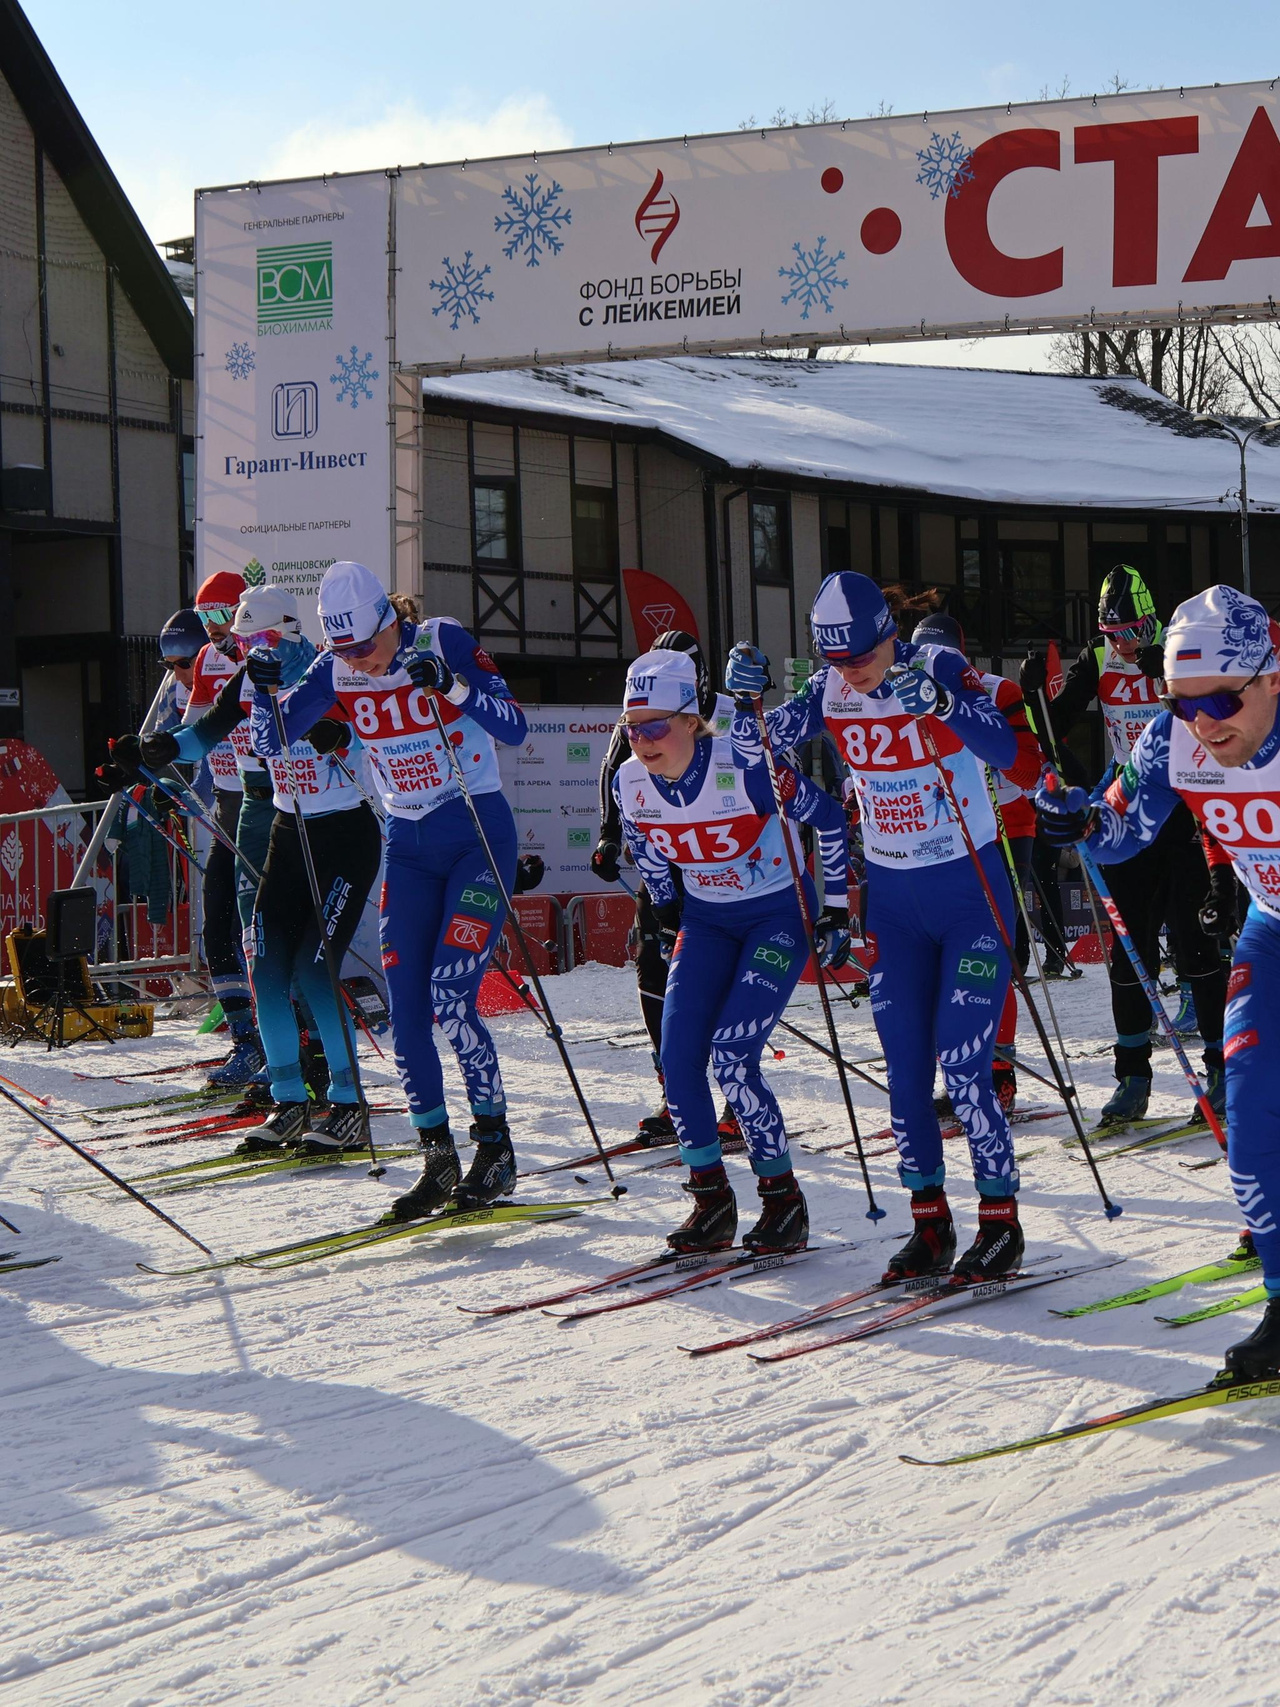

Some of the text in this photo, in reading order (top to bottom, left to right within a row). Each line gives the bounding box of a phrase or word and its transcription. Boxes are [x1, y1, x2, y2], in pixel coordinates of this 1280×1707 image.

[243, 211, 345, 231] ГЕНЕРАЛЬНЫЕ ПАРТНЕРЫ
[580, 268, 742, 300] ФОНД БОРЬБЫ
[579, 290, 742, 326] С ЛЕЙКЕМИЕЙ
[257, 318, 334, 337] БИОХИММАК
[223, 448, 368, 480] Гарант-Инвест
[240, 519, 351, 534] ОФИЦИАЛЬНЫЕ ПАРТНЕРЫ
[271, 558, 337, 571] ОДИНЦОВСКИЙ
[271, 574, 294, 584] ПАРК
[285, 588, 305, 596] ОРТА
[814, 625, 851, 645] RWT
[627, 676, 658, 690] RWT
[893, 671, 915, 686] COXA
[353, 689, 440, 735] 810
[1124, 708, 1164, 719] ЛЫЖН
[383, 740, 430, 756] ЛЫЖНЯ
[842, 719, 926, 766] 821
[272, 759, 315, 770] САОЕ
[387, 751, 435, 768] САМОЕ
[274, 770, 318, 781] ВРМЯ
[392, 762, 440, 780] ВРЕМЯ
[278, 782, 319, 795] ЖТЬ
[395, 774, 443, 793] ЖИТЬ
[559, 778, 598, 787] samolet
[869, 778, 918, 792] ЛЫЖНЯ
[872, 791, 922, 807] САМОЕ
[1038, 799, 1060, 815] OXA
[874, 803, 925, 820] ВРЕМЯ
[878, 818, 927, 834] ЖИТЬ
[649, 824, 740, 860] 813
[870, 845, 909, 859] КОМАНДА
[323, 876, 345, 920] PRO
[460, 889, 498, 912] BCM
[313, 882, 353, 964] TENER
[753, 947, 791, 974] BCM
[957, 958, 996, 980] BCM
[756, 977, 779, 993] COXA
[968, 995, 991, 1006] COXA
[721, 1139, 746, 1150] ROSSIGN
[482, 1150, 511, 1188] SPINE
[451, 1209, 494, 1226] FISCHER
[980, 1231, 1011, 1267] MADSHUS
[675, 1255, 708, 1270] MADSHUS
[752, 1256, 785, 1271] MADSHUS
[904, 1277, 940, 1293] MADSHUS
[972, 1282, 1008, 1298] MADSHUS
